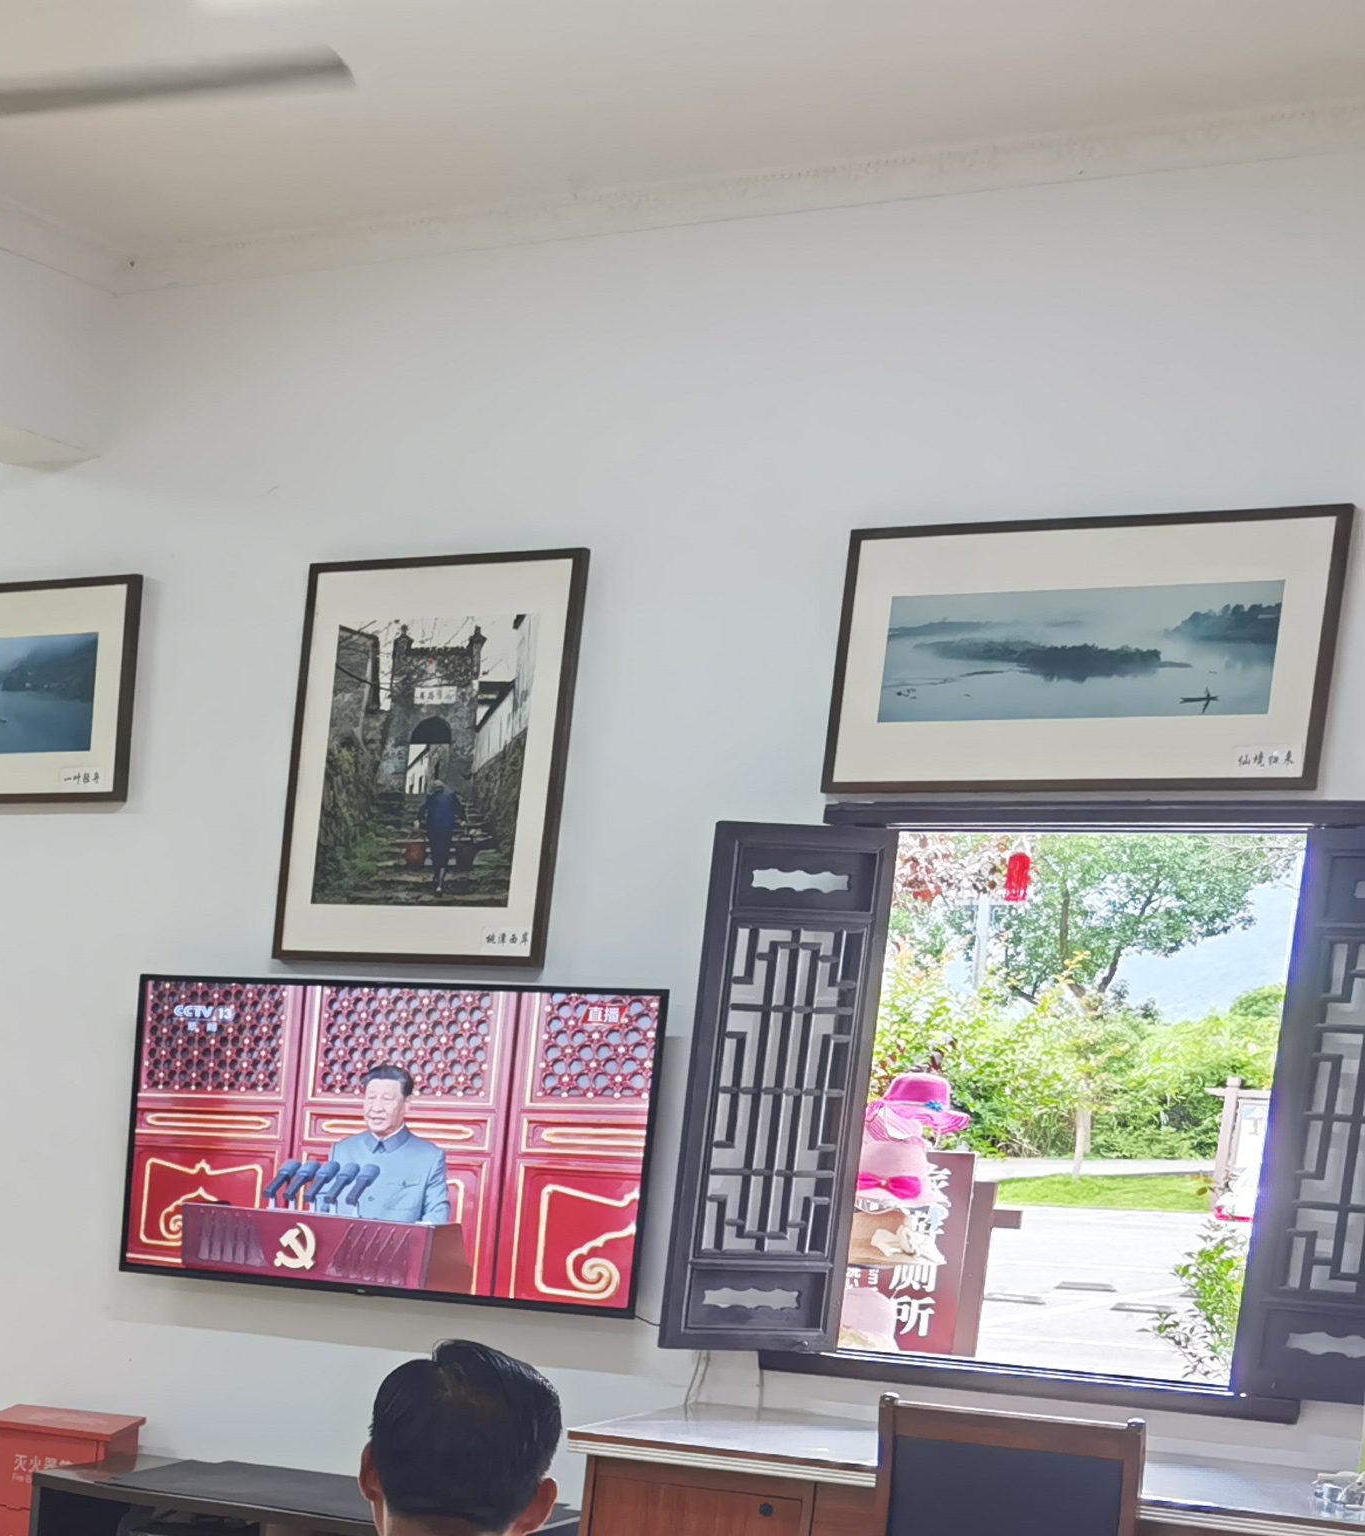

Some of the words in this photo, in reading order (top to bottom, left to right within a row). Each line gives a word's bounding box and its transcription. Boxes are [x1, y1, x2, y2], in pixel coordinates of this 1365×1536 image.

[64, 771, 100, 785] 一叶轻舟
[174, 1004, 214, 1018] CCTV
[218, 1007, 232, 1020] 13
[587, 1006, 620, 1023] 直播
